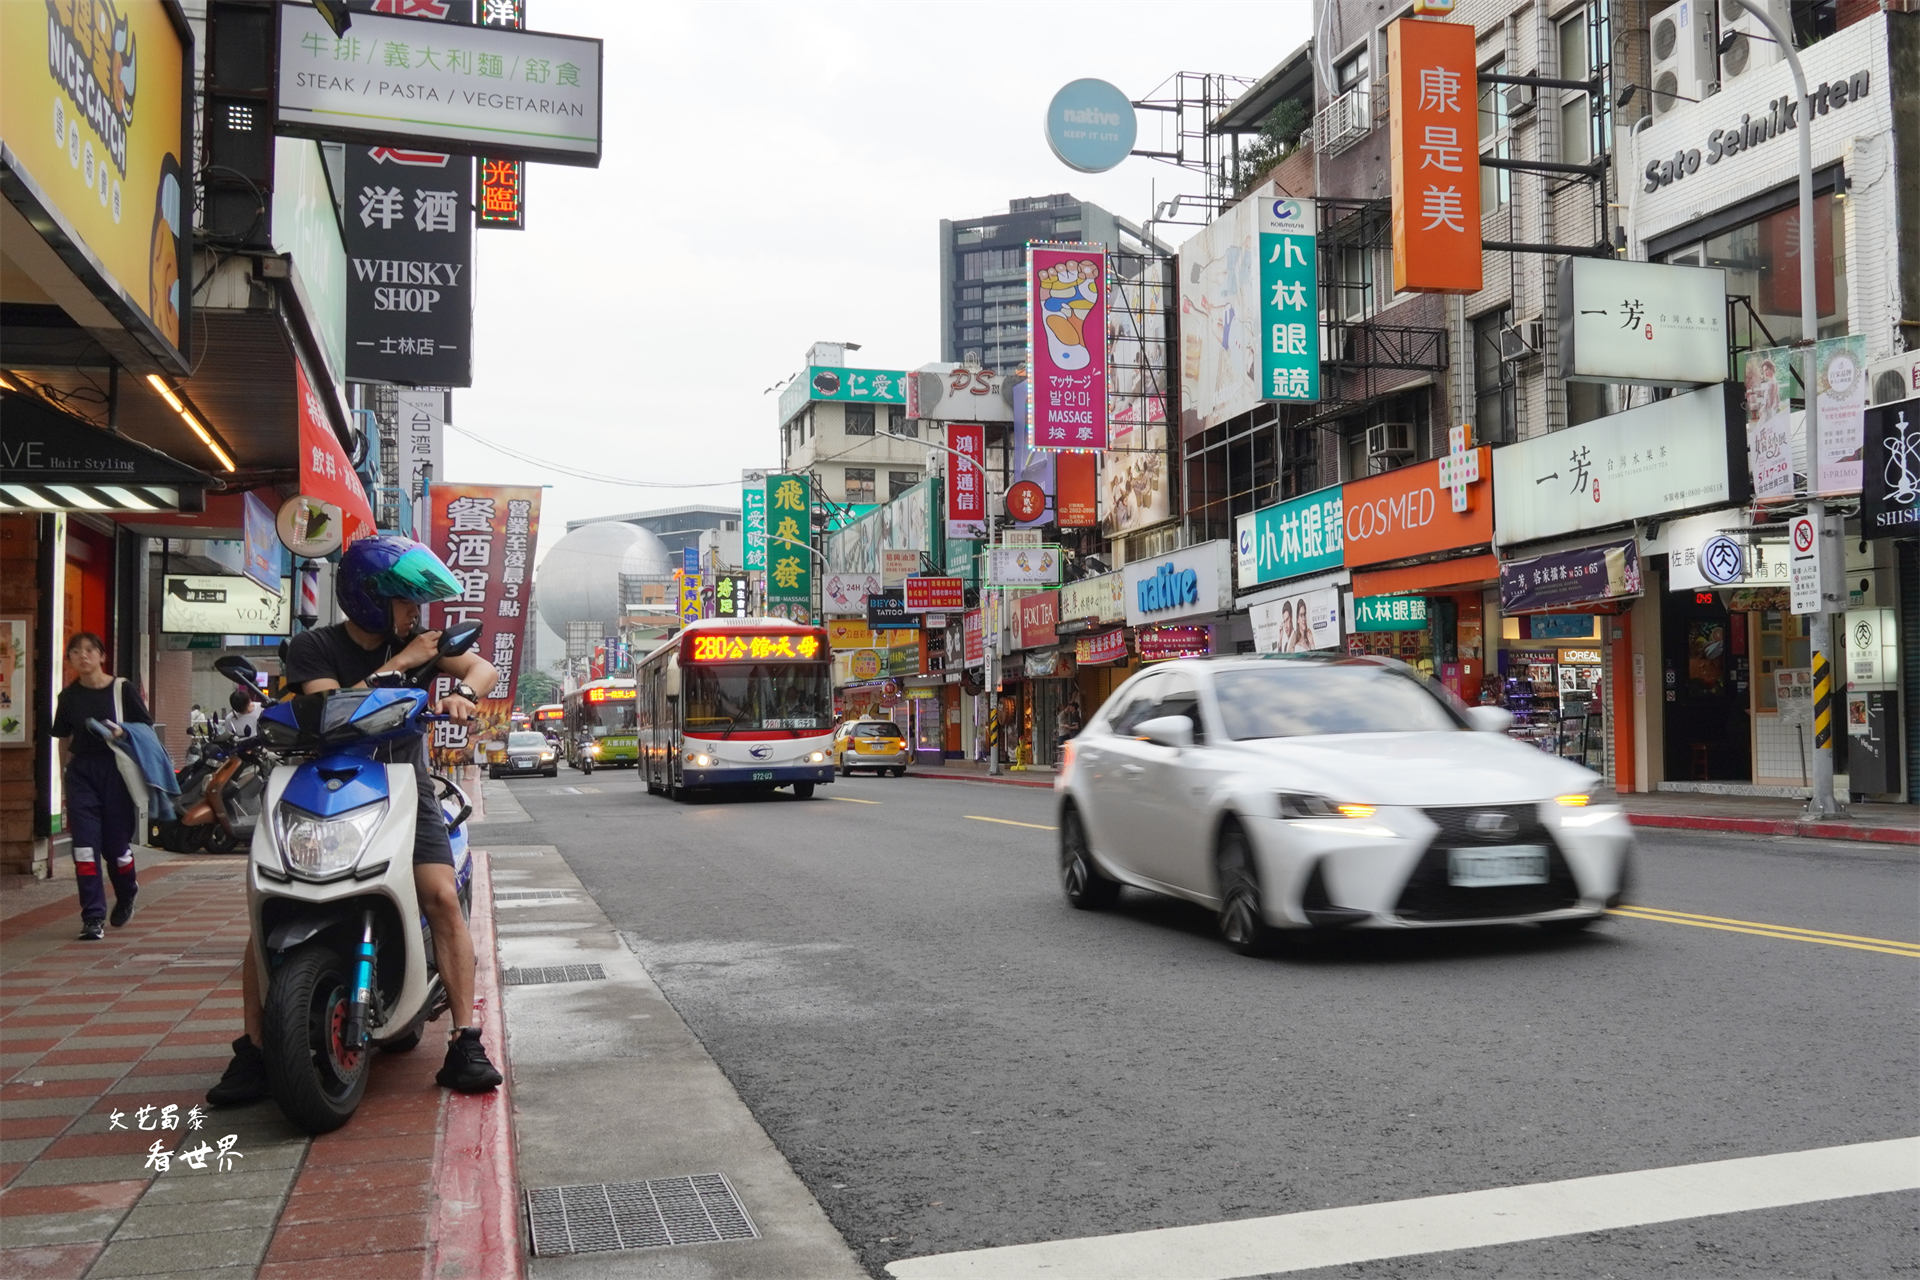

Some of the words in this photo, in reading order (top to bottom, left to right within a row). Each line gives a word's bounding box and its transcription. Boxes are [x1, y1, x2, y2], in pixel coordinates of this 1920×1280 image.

[50, 17, 84, 105] NICE
[86, 73, 126, 171] CATCH
[297, 72, 356, 94] STEAK
[379, 81, 440, 102] PASTA
[463, 90, 585, 118] VEGETARIAN
[1064, 107, 1120, 126] native
[1064, 130, 1086, 139] KEEP
[1089, 131, 1098, 139] IT
[1101, 133, 1119, 141] LITE
[1417, 66, 1464, 233] 康是美
[1644, 148, 1701, 193] Sato
[486, 160, 514, 212] 光臨
[358, 185, 459, 233] 洋酒
[352, 258, 463, 287] WHISKY
[374, 286, 442, 313] SHOP
[1269, 236, 1310, 398] 小林眼鏡
[1580, 299, 1645, 331] 一芳
[380, 336, 434, 357] 士林店
[949, 369, 996, 397] PS
[1049, 375, 1091, 388] マッサージ
[1050, 390, 1091, 407] 발안마
[1048, 410, 1093, 423] MASSAGE
[1048, 426, 1093, 441] 按摩
[0, 442, 44, 468] VE
[51, 457, 81, 469] Hair
[85, 457, 135, 471] Styling
[1536, 446, 1592, 495] 一芳
[956, 435, 974, 510] 鴻景通信
[1758, 461, 1788, 484] 5/17-20
[1347, 487, 1435, 541] COSMED
[746, 493, 766, 566] 仁愛眼鏡
[772, 479, 807, 589] 飛來發
[1259, 497, 1344, 570] 小林眼鏡
[498, 499, 531, 618] 營業至凌晨3點
[1573, 566, 1583, 577] 55
[1588, 563, 1598, 574] 65
[1671, 547, 1696, 568] 佐藤
[846, 583, 861, 591] 24H
[1137, 562, 1197, 612] native
[236, 608, 268, 621] VOL
[1040, 604, 1055, 625] TEA
[1356, 600, 1426, 622] 小林眼鏡
[694, 637, 727, 659] 280
[1350, 635, 1364, 648] 大
[1376, 632, 1390, 646] 大
[1402, 632, 1416, 646] 大
[608, 638, 616, 672] SAMSUNG
